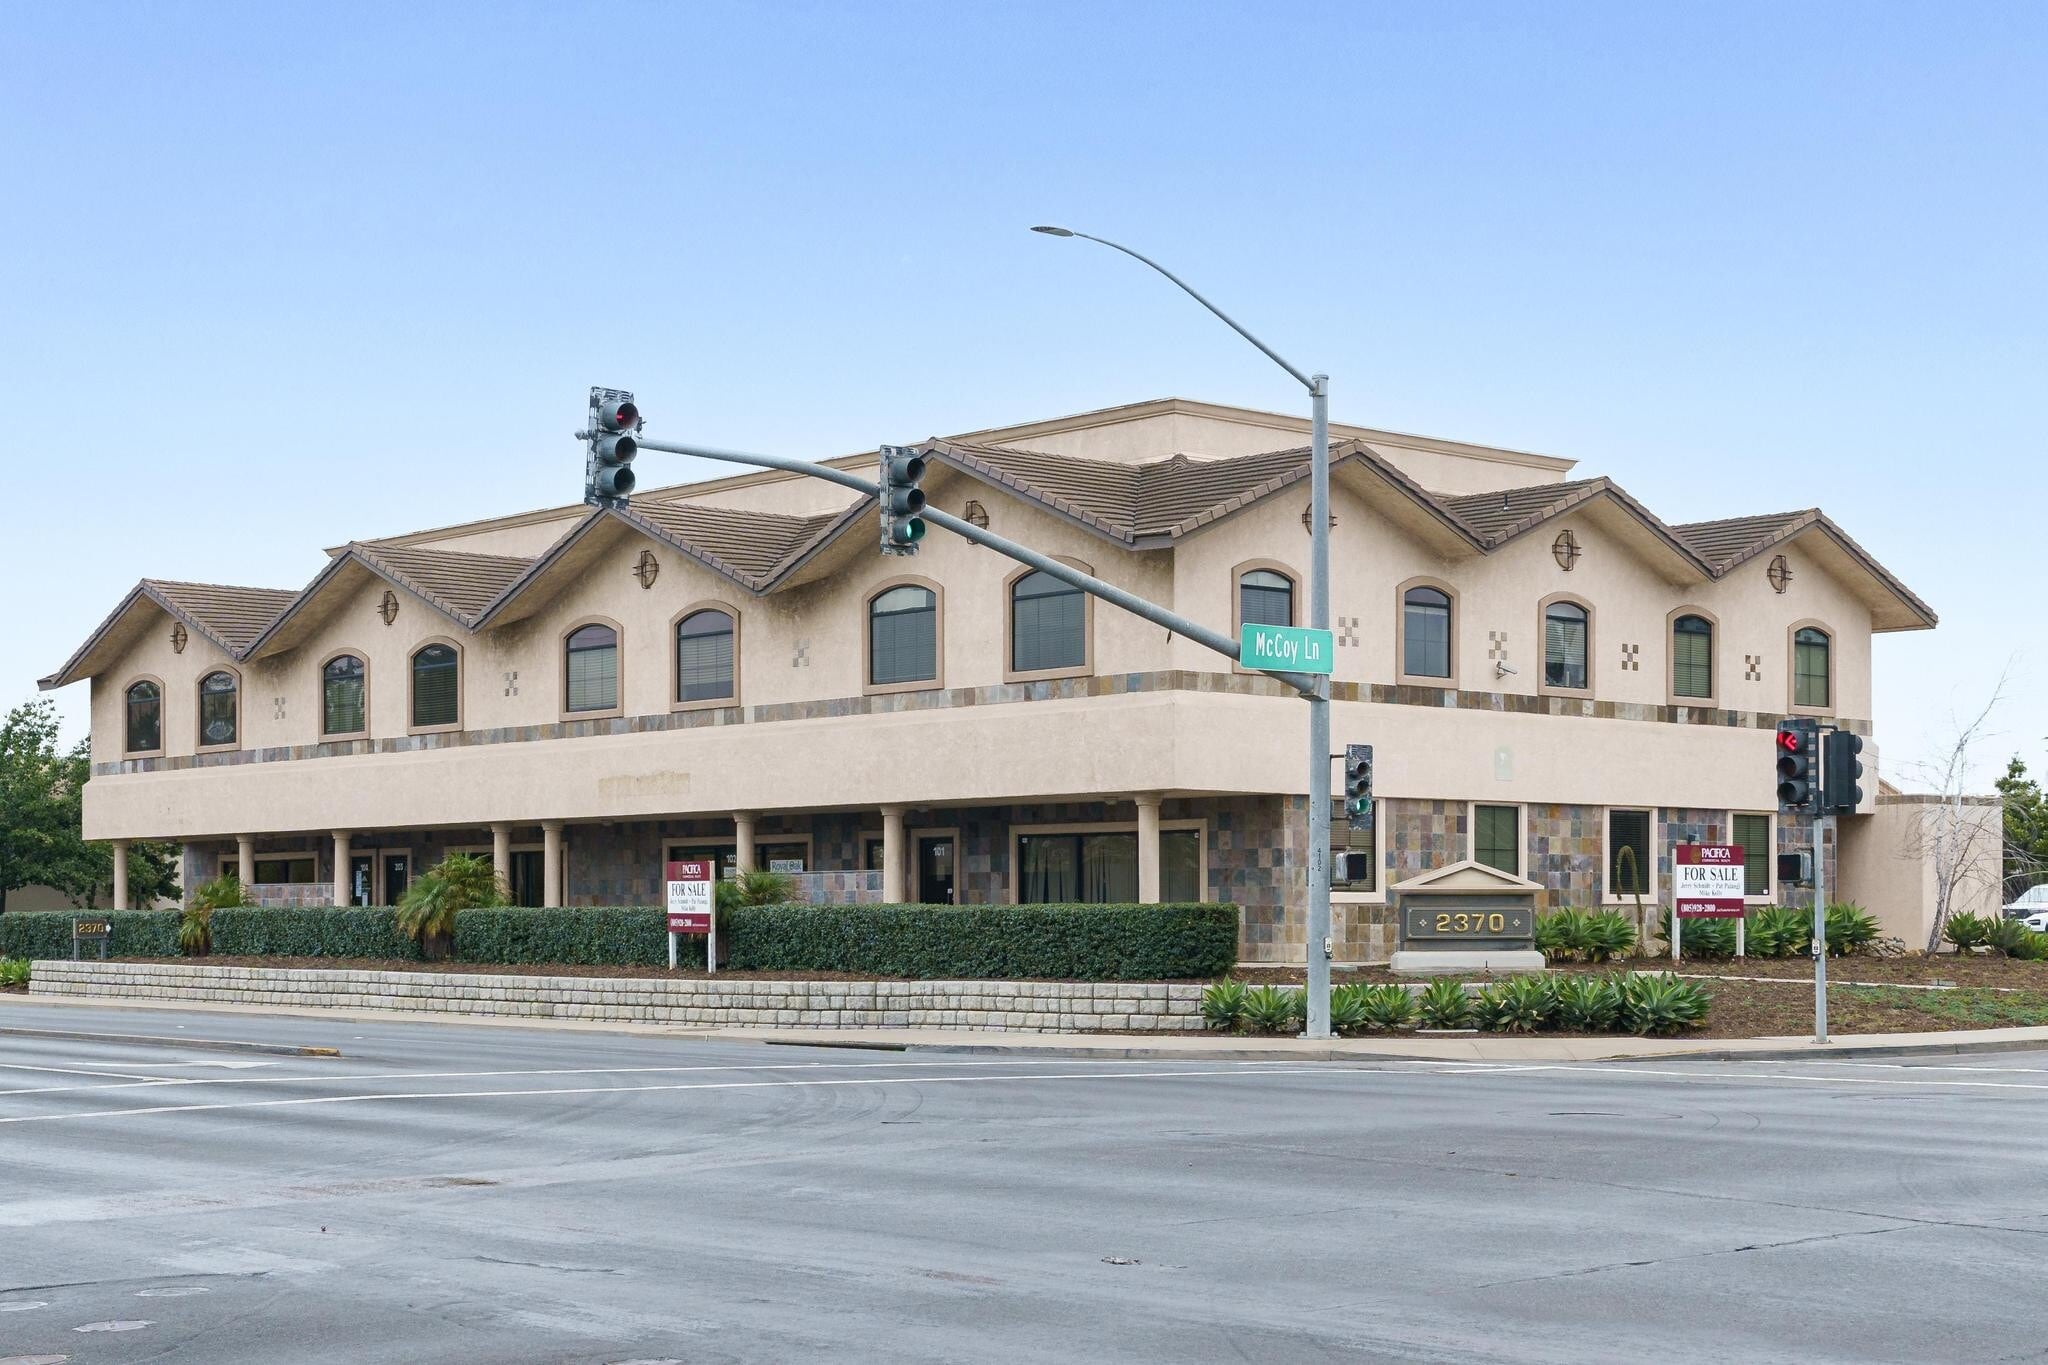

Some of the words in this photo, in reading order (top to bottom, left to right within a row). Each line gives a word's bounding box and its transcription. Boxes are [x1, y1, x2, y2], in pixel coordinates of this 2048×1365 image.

[1255, 631, 1298, 665] McCoy
[1304, 635, 1319, 660] Ln
[933, 847, 945, 856] 101
[1701, 848, 1731, 859] PACIFICA
[771, 861, 788, 873] Royal
[1684, 867, 1706, 881] FOR
[1710, 867, 1738, 881] SALE
[671, 883, 686, 897] FOR
[688, 883, 706, 897] SALE
[79, 923, 104, 933] 2370
[1435, 913, 1504, 933] 2370
